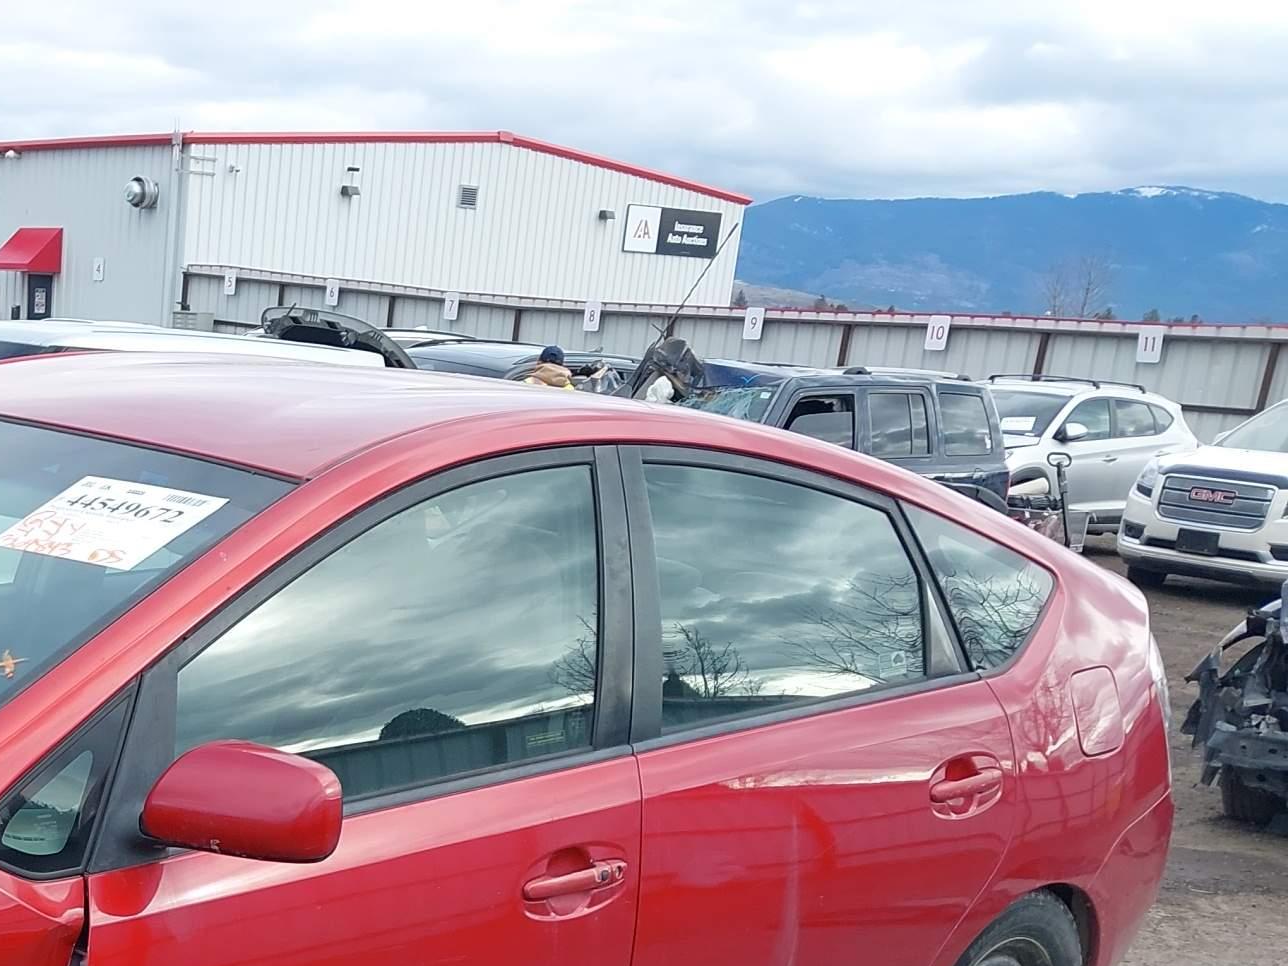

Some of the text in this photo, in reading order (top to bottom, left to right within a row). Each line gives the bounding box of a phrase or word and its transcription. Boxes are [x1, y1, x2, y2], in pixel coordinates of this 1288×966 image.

[667, 233, 682, 243] Auto
[95, 263, 101, 275] 4
[227, 276, 233, 288] 5
[329, 287, 335, 298] 6
[448, 299, 455, 312] 7
[589, 310, 595, 322] 8
[750, 316, 758, 330] 9
[930, 325, 945, 340] 10
[1143, 336, 1156, 352] 11
[1191, 487, 1236, 506] GMC
[67, 494, 185, 524] 44549672
